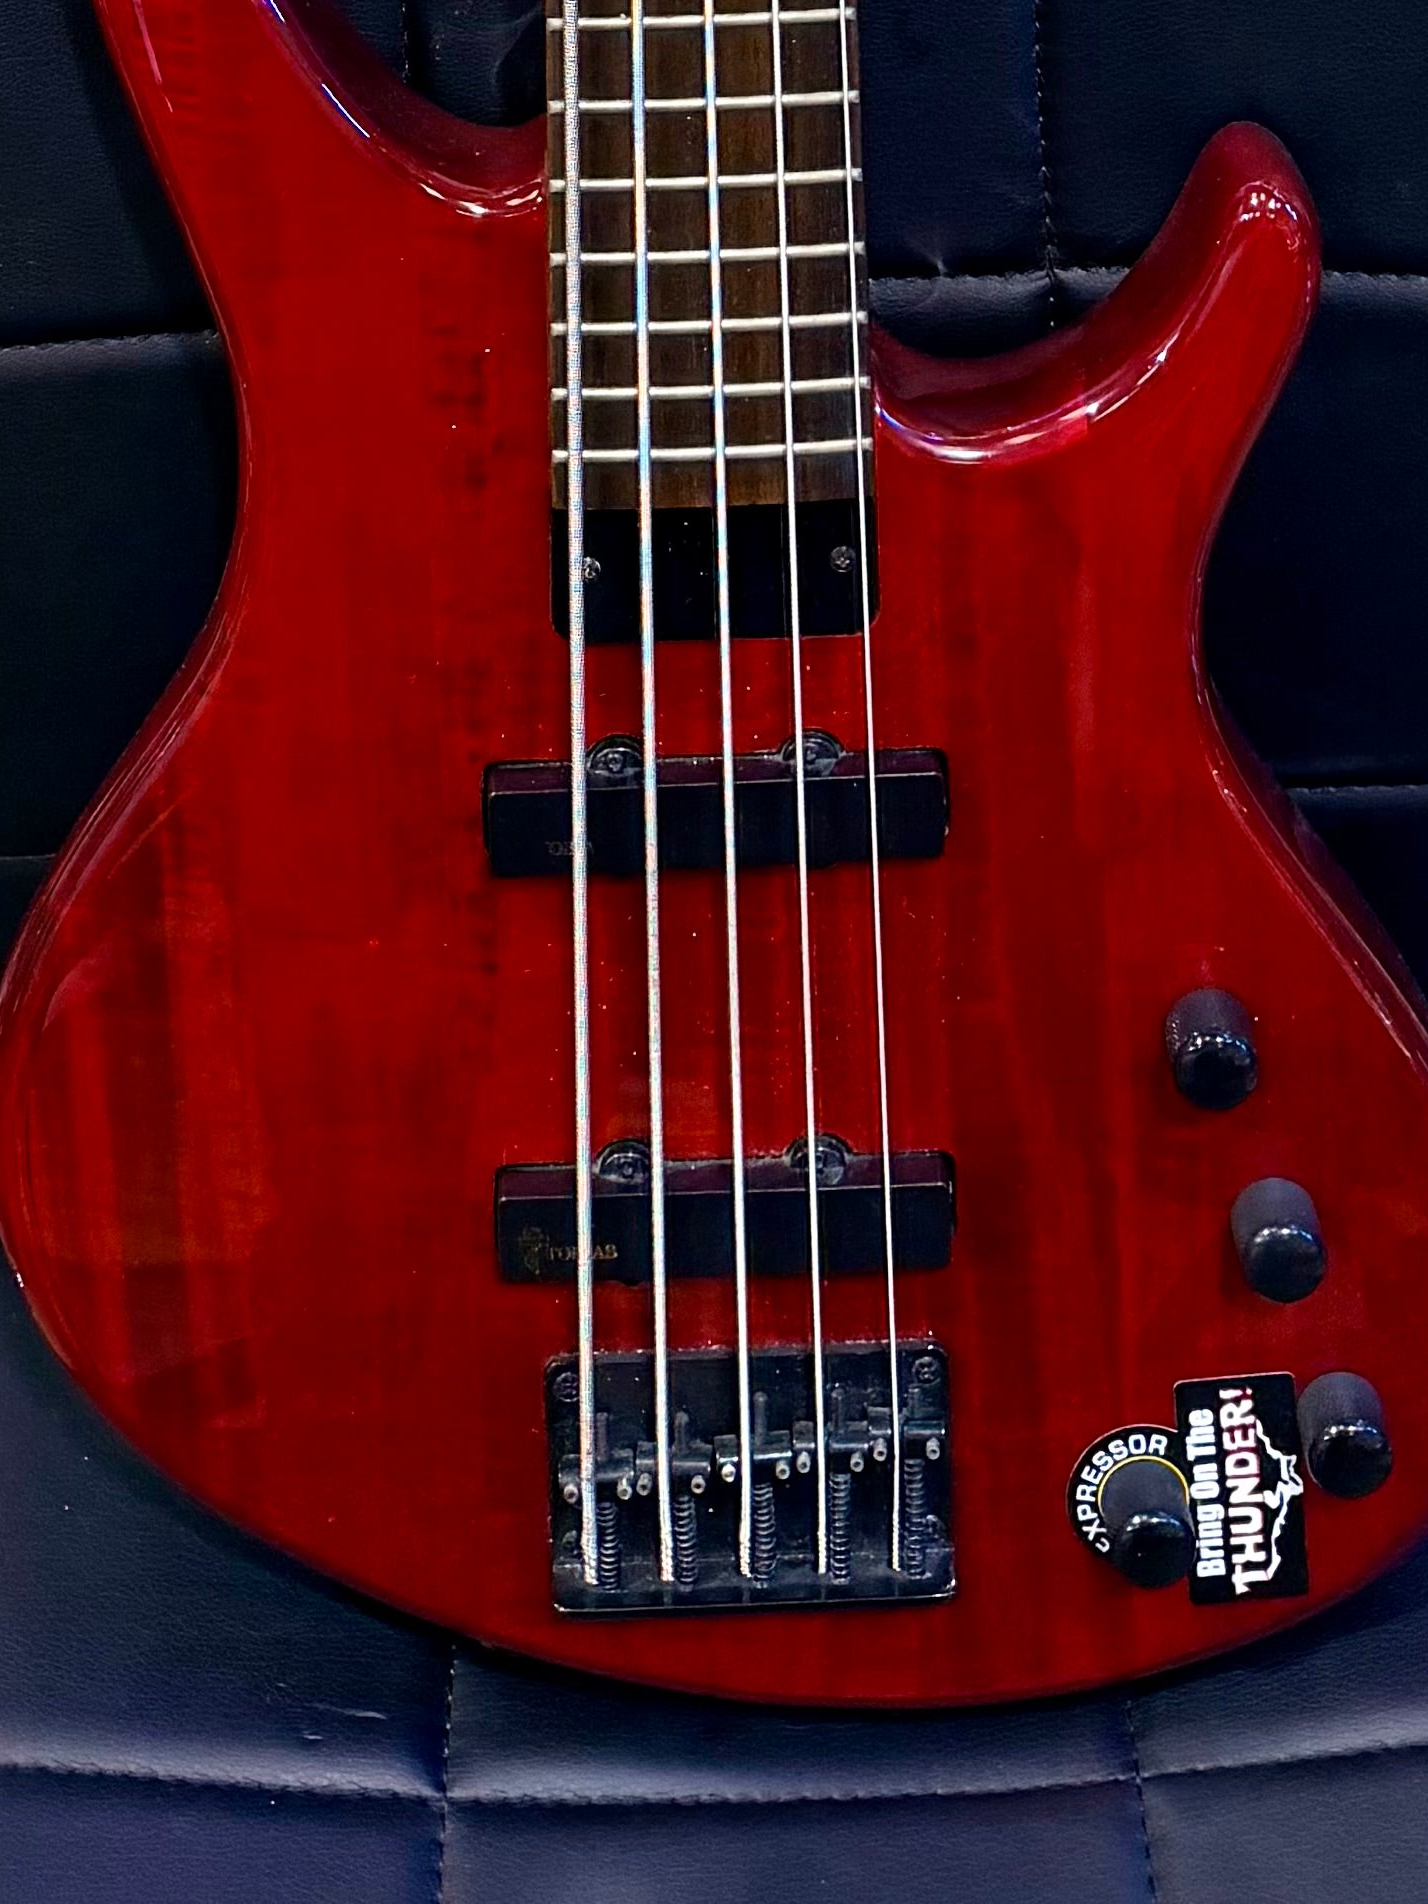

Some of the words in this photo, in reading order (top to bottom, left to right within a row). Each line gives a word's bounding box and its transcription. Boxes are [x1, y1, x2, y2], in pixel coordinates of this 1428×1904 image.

[1185, 1408, 1217, 1461] The
[1190, 1462, 1220, 1500] On
[1219, 1387, 1271, 1596] THUNDER!
[1196, 1503, 1227, 1578] Bring
